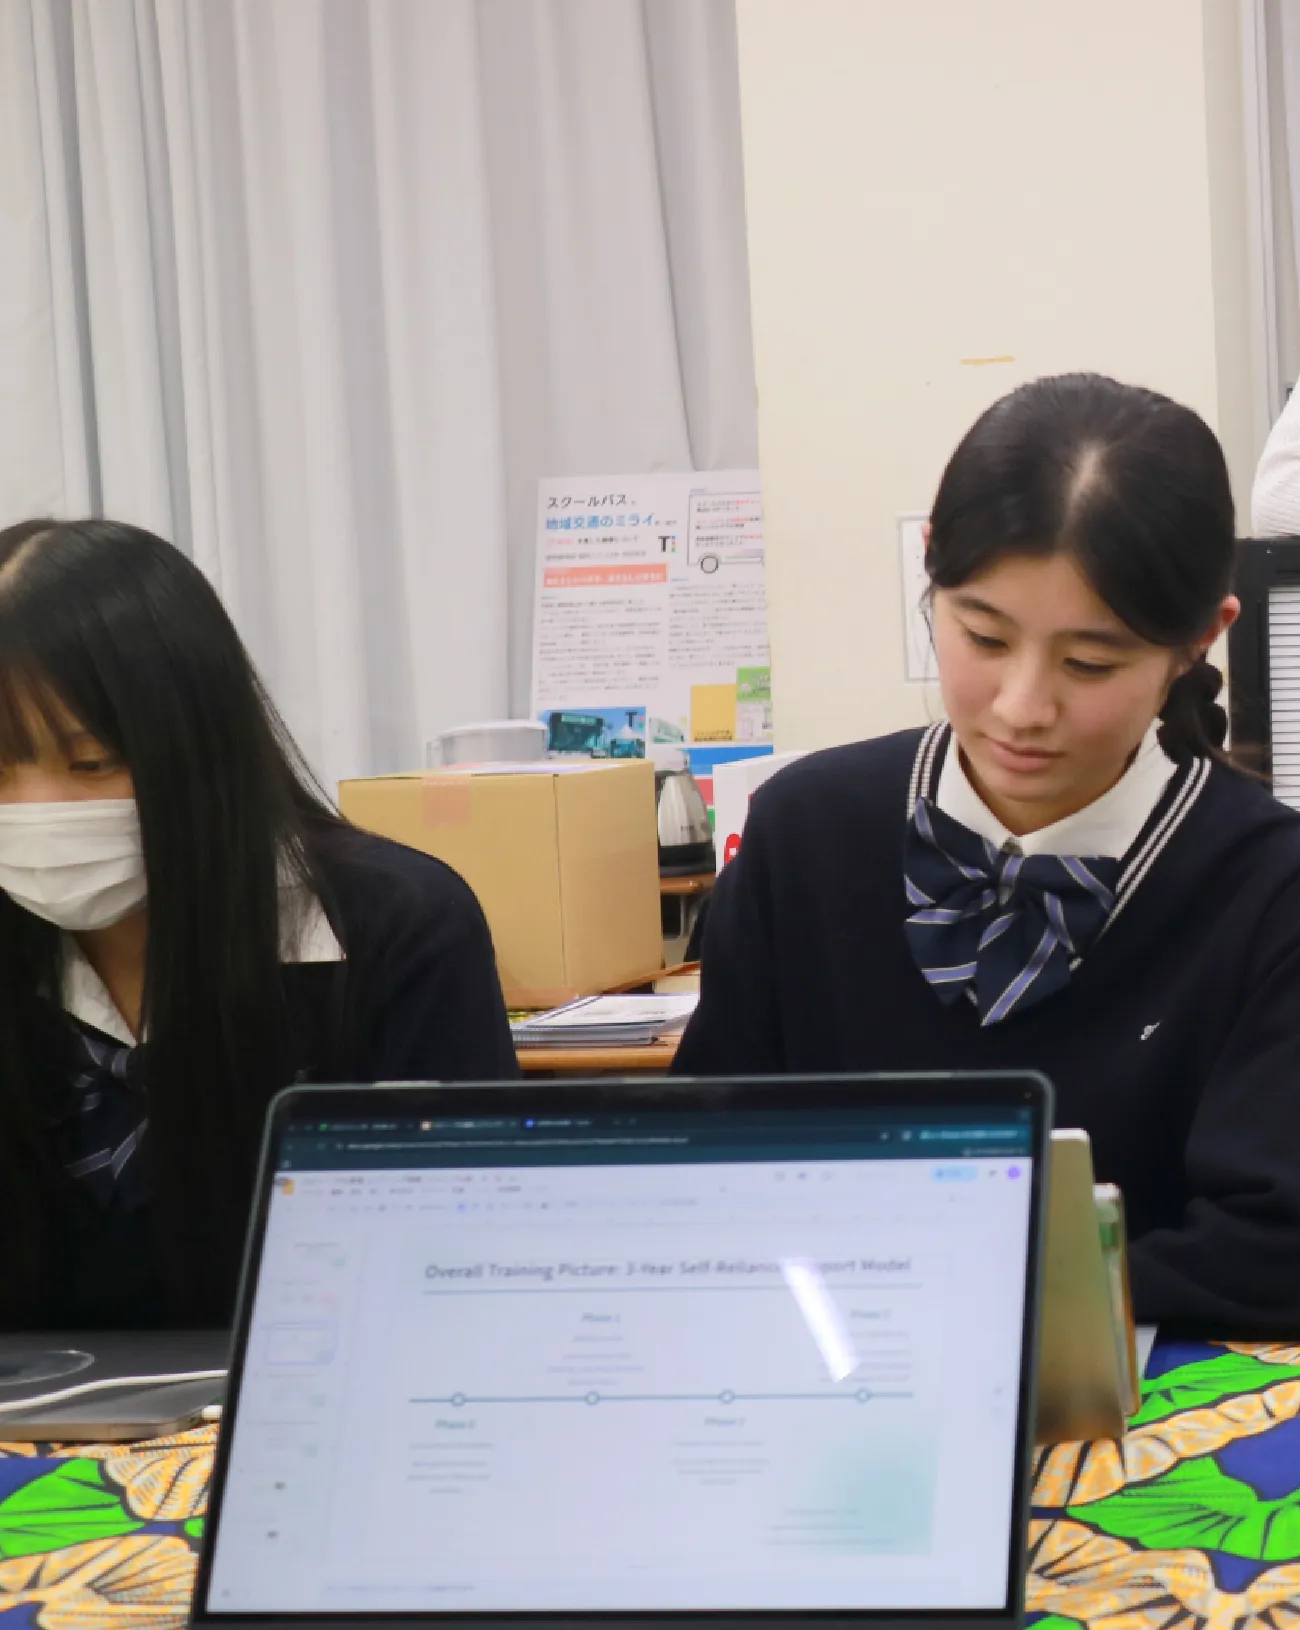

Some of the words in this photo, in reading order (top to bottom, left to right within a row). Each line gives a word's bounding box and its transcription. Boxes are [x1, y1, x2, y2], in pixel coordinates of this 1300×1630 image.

[545, 512, 654, 531] 地域交通のミライ
[424, 1264, 483, 1279] Overall
[488, 1263, 554, 1281] Training
[860, 1258, 913, 1272] Model
